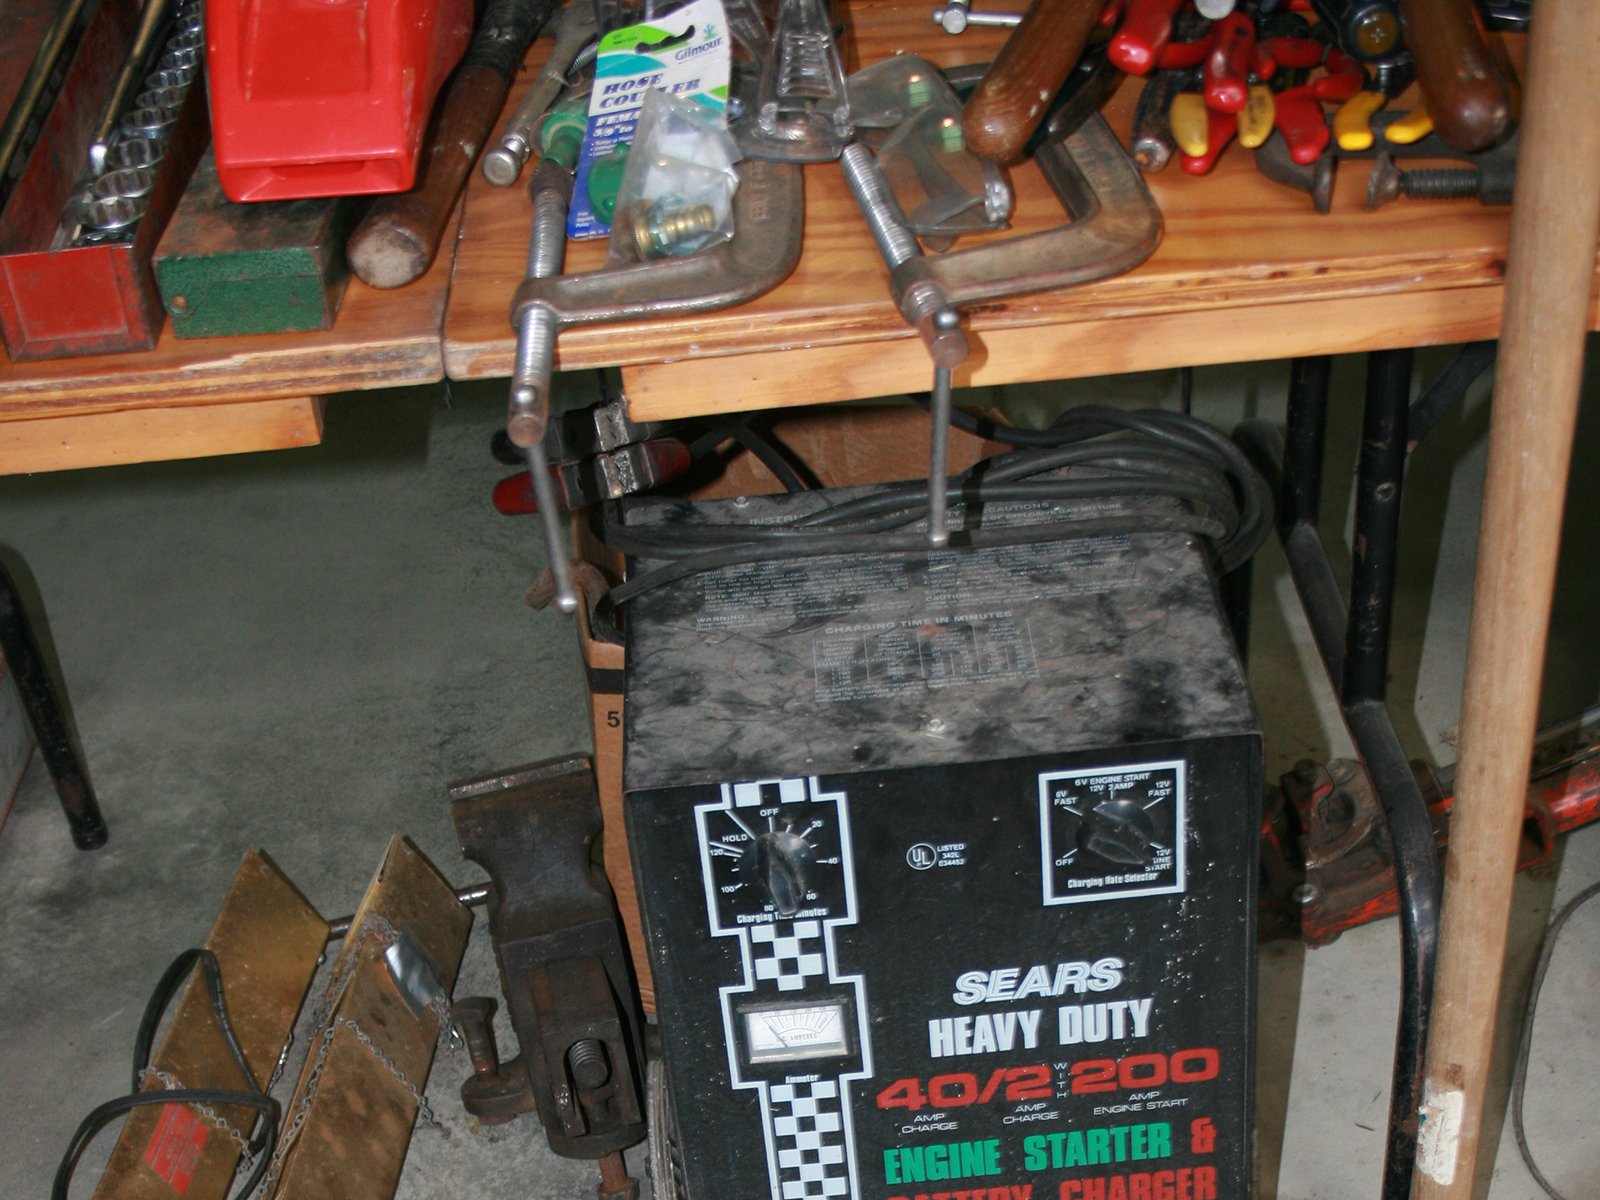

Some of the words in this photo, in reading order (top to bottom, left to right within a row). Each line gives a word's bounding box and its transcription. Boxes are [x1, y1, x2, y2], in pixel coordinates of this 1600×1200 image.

[675, 37, 724, 61] Gilmour
[602, 74, 664, 96] HOSE
[599, 78, 700, 109] COULER
[595, 110, 641, 127] FEMA
[982, 502, 1049, 513] CAUTIONS
[825, 621, 896, 634] CHARGING
[900, 618, 930, 627] TIME
[953, 610, 1013, 623] MINUTES
[607, 710, 620, 728] 5
[1075, 778, 1088, 787] 6V
[1090, 775, 1123, 785] ENGINE
[1123, 772, 1150, 782] START
[1155, 780, 1170, 788] 12V
[1055, 790, 1068, 798] 6V
[1148, 788, 1171, 797] FAST
[1054, 797, 1077, 806] FAST
[760, 808, 779, 817] OFF
[811, 820, 823, 828] 20
[722, 834, 748, 843] HOLD
[937, 843, 966, 852] LISTED
[1156, 848, 1171, 856] 12V
[912, 848, 932, 866] UL
[1055, 858, 1073, 867] OFF
[1068, 877, 1103, 889] Charging
[1105, 875, 1123, 885] Rate
[1124, 872, 1160, 884] Selector
[721, 886, 735, 894] 100
[737, 911, 773, 924] Charging
[953, 956, 1125, 1006] SEARS
[929, 1009, 1041, 1058] HEAVY
[1059, 999, 1153, 1045] DUTY
[785, 1074, 819, 1084] Ammeter
[876, 1062, 1053, 1111] 40/2
[1053, 1061, 1068, 1099] WITH
[1071, 1047, 1220, 1095] 200
[1128, 1091, 1160, 1102] AMP
[1015, 1102, 1047, 1113] AMP
[1093, 1103, 1142, 1115] ENGINE
[1145, 1098, 1188, 1111] START
[913, 1113, 946, 1123] AMP
[1003, 1111, 1058, 1125] CHARGE
[901, 1121, 958, 1134] CHARGE
[883, 1139, 1002, 1185] ENGINE
[1023, 1121, 1172, 1171] STARTER
[1190, 1117, 1216, 1154] &
